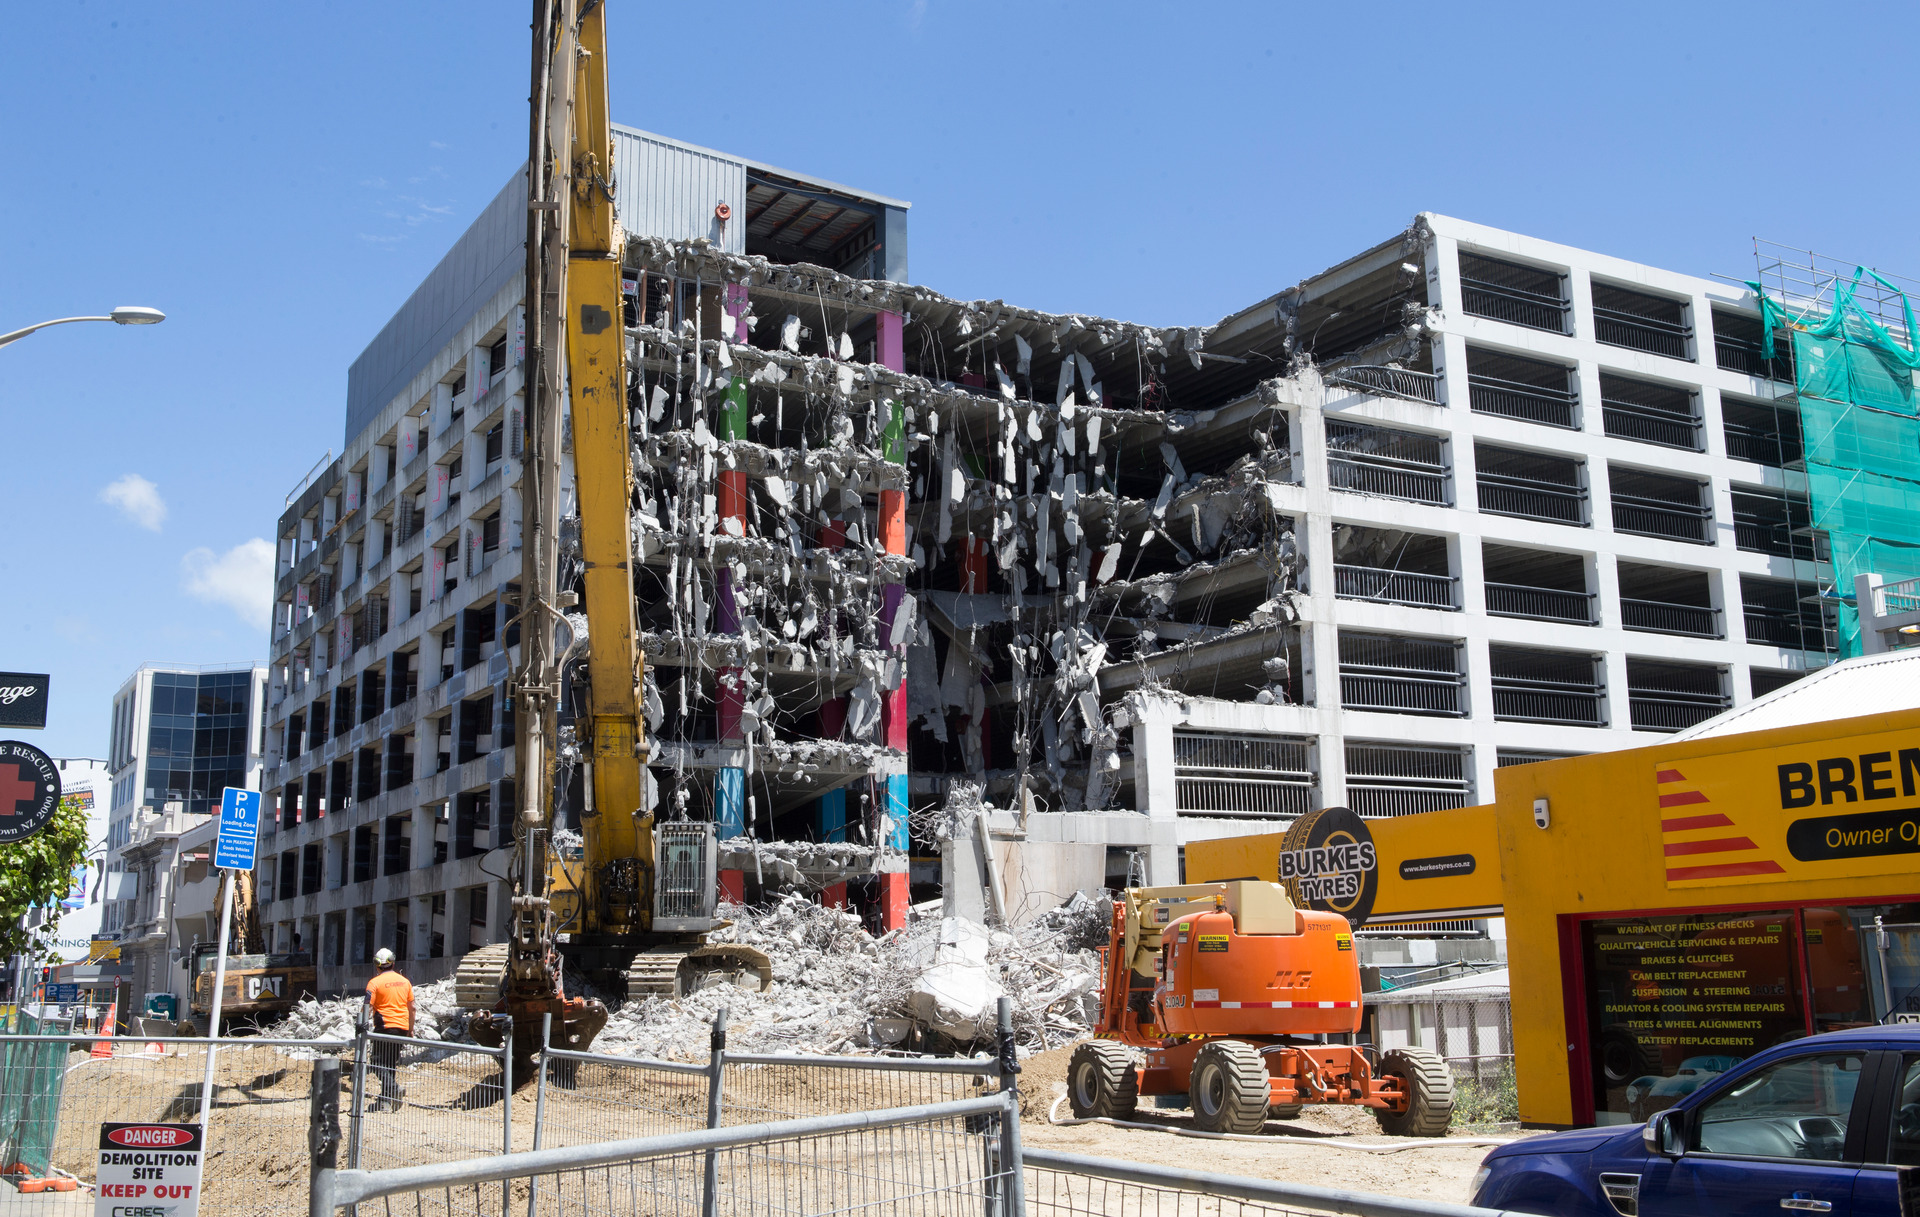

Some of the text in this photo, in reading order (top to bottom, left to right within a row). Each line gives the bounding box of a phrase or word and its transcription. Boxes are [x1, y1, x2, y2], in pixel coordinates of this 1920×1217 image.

[12, 746, 54, 782] RESCUE
[235, 791, 248, 806] P
[36, 795, 54, 820] 2000
[234, 808, 246, 819] 10
[20, 818, 36, 832] NZ
[222, 819, 256, 829] Loading Zone
[1826, 821, 1920, 848] Owner O
[1280, 840, 1376, 880] BURKES
[1404, 861, 1470, 873] www.burkestyres.co.nz
[1300, 873, 1359, 901] TYRES
[1617, 920, 1755, 934] WARRANT OF FITNESS CHECKS
[1600, 936, 1779, 950] QUALITY VEHICLE SERVICING & REPAIRS
[1641, 954, 1734, 965] BRAKES & CLUTCHES
[1266, 971, 1312, 989] JLG
[1632, 970, 1746, 981] CAM BELT REPLACEMENT
[249, 976, 283, 1000] CAT
[1632, 987, 1750, 996] SUSPENSION & STEERING
[1606, 1003, 1785, 1012] RADIATOR & COOLING SYSTEM REPAIRS
[1628, 1020, 1762, 1029] TYRES & WHEEL ALIGNMENTS
[1638, 1036, 1754, 1046] BATTERY REPLACEMENTS
[124, 1130, 176, 1144] DANGER
[101, 1153, 198, 1166] DEMOLITION
[132, 1167, 164, 1180] SITE
[101, 1184, 193, 1199] KEEP OUT
[112, 1206, 165, 1217] CERES
